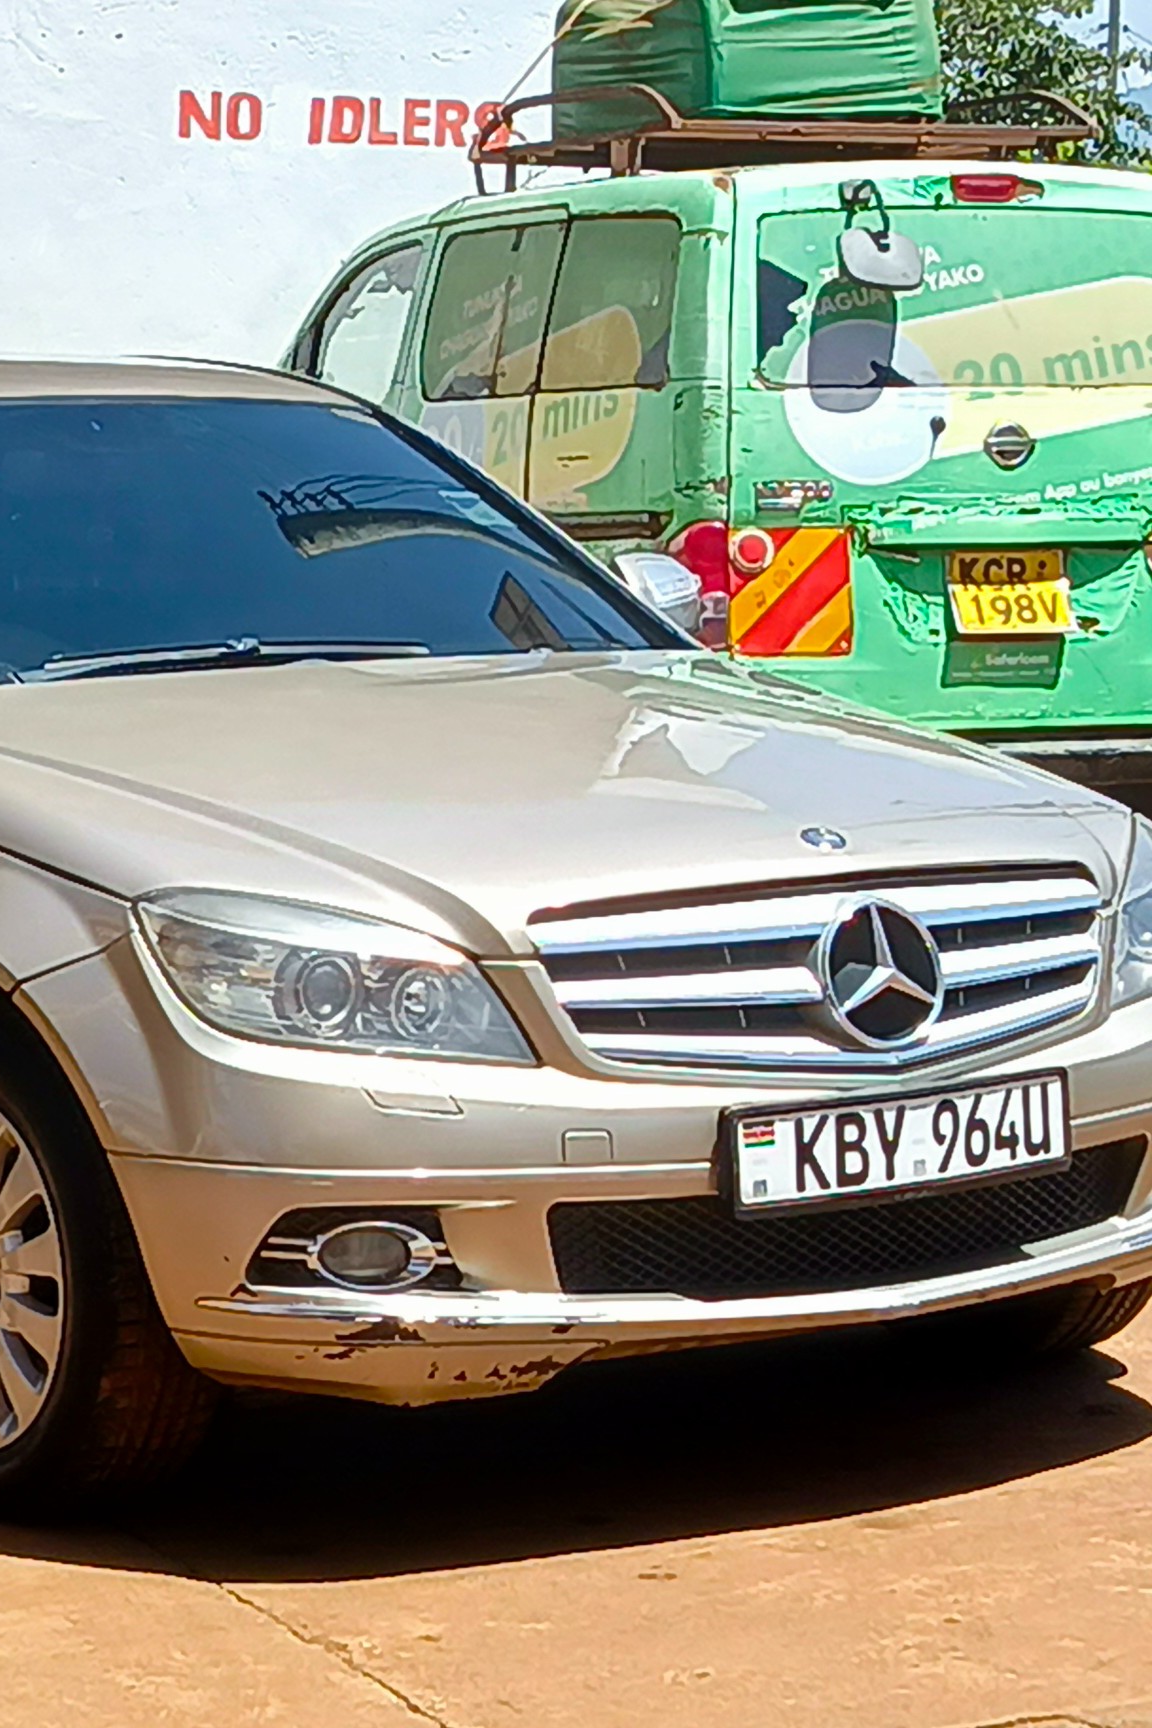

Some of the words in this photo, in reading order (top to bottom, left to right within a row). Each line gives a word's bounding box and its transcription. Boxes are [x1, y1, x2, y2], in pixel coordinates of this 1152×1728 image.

[178, 90, 263, 141] NO
[923, 263, 985, 292] YAKO
[952, 352, 1025, 401] 20
[1042, 334, 1152, 385] min
[958, 557, 1031, 592] KCR
[970, 591, 1058, 626] 198V
[794, 1104, 906, 1193] KBY
[932, 1081, 1052, 1174] 964U
